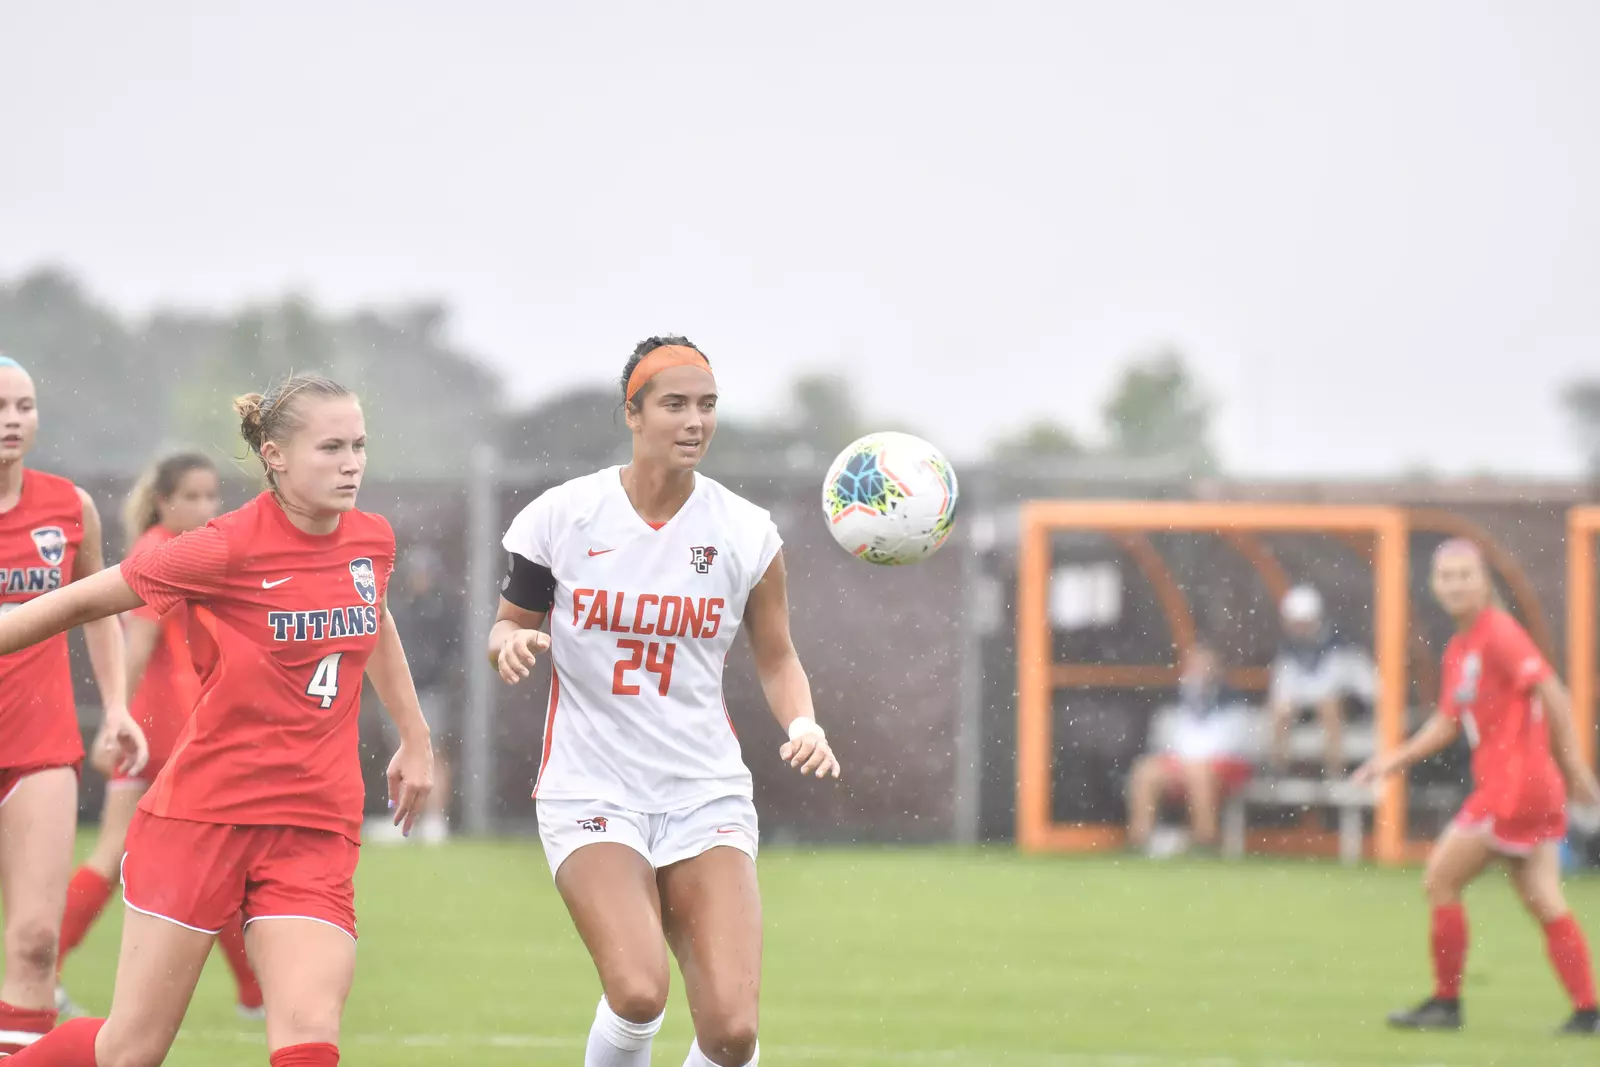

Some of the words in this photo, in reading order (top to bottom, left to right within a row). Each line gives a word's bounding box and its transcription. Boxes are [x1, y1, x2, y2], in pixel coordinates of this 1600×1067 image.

[268, 605, 377, 641] TITANS
[572, 588, 725, 639] FALCONS
[305, 652, 344, 709] 4
[612, 639, 676, 697] 24
